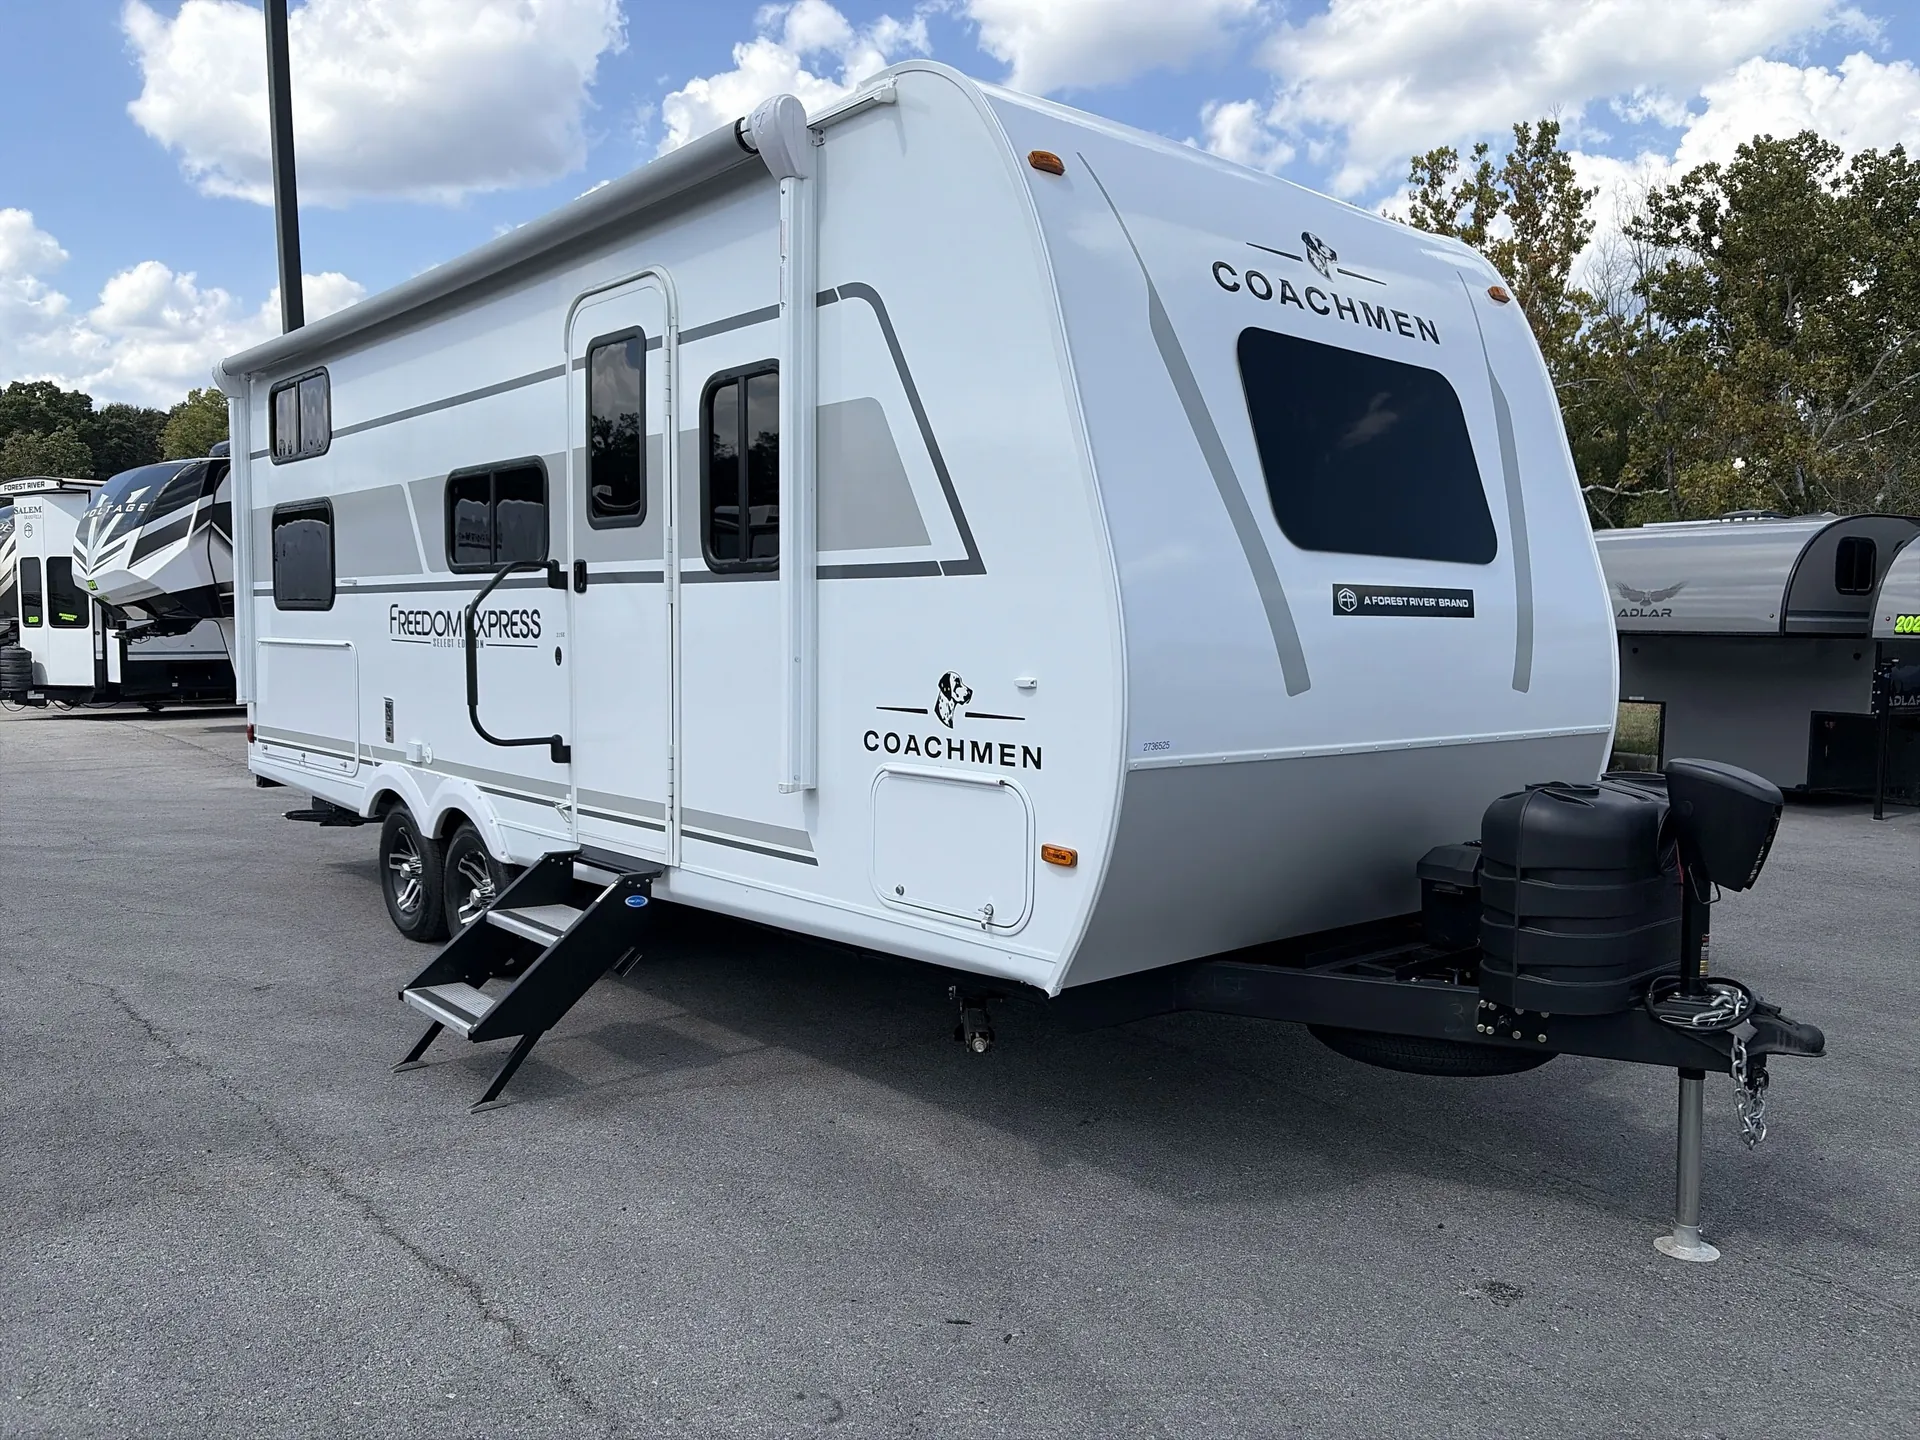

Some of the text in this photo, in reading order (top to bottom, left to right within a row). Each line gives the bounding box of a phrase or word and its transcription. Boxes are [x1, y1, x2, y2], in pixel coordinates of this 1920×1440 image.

[1212, 260, 1441, 345] COACHMEN
[4, 481, 45, 491] FOREST RIVER
[14, 506, 42, 514] SALEM
[83, 503, 148, 519] VOLTAGE
[1364, 596, 1469, 608] A FOREST RIVER BRAND
[1617, 608, 1672, 618] ADLAR
[389, 604, 462, 637] FREEDOM
[432, 638, 484, 649] SELECT EDON
[863, 729, 1042, 770] COACHMEN
[1143, 740, 1170, 751] 2736525
